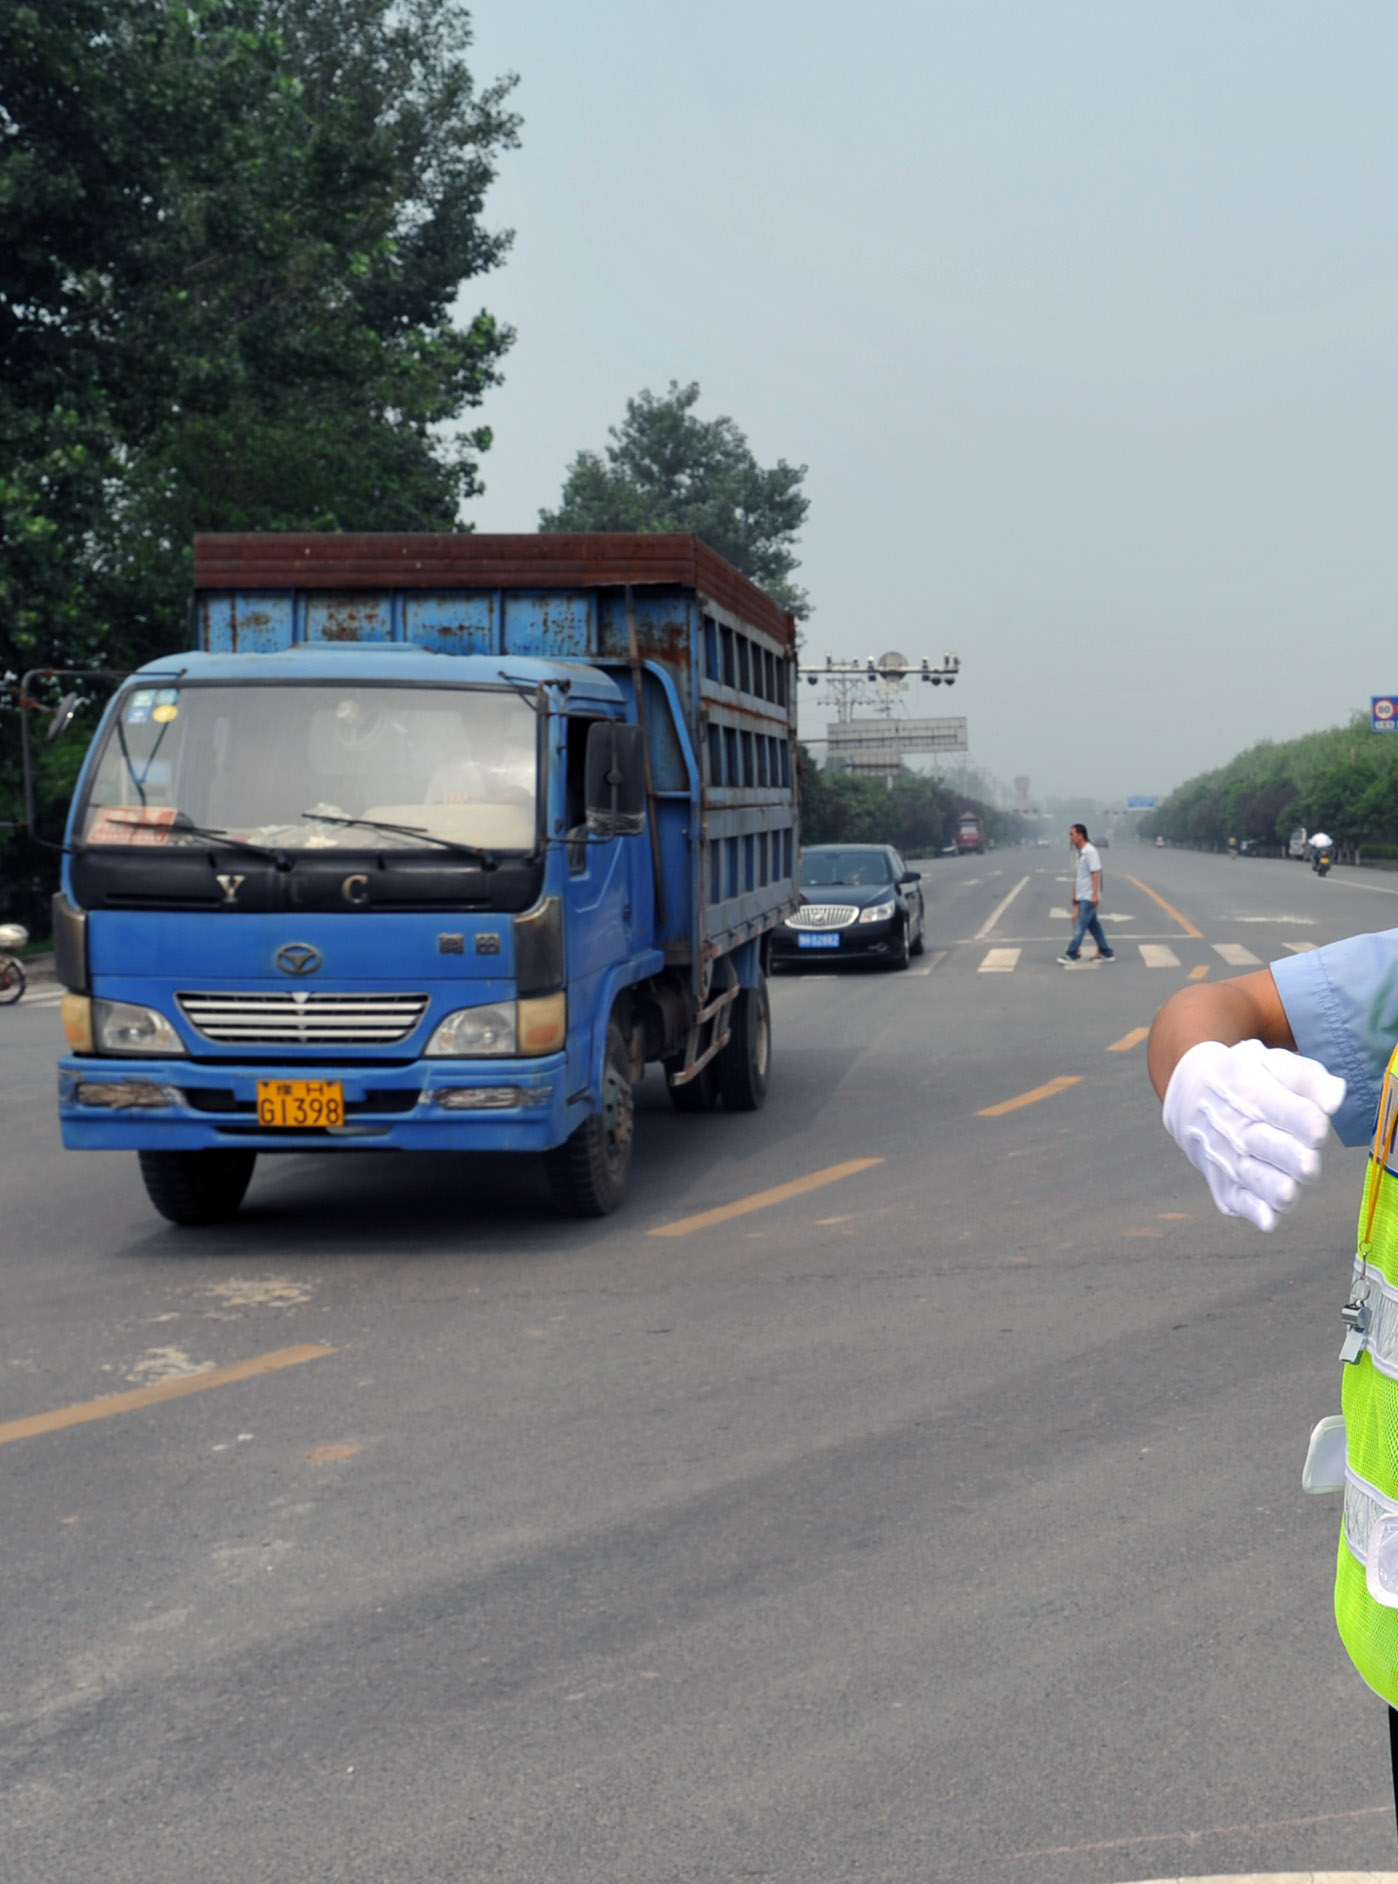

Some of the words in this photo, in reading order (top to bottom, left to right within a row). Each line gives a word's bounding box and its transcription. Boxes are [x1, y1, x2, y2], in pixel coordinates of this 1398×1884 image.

[216, 874, 246, 903] Y
[341, 874, 369, 904] C
[261, 1098, 340, 1125] G1398
